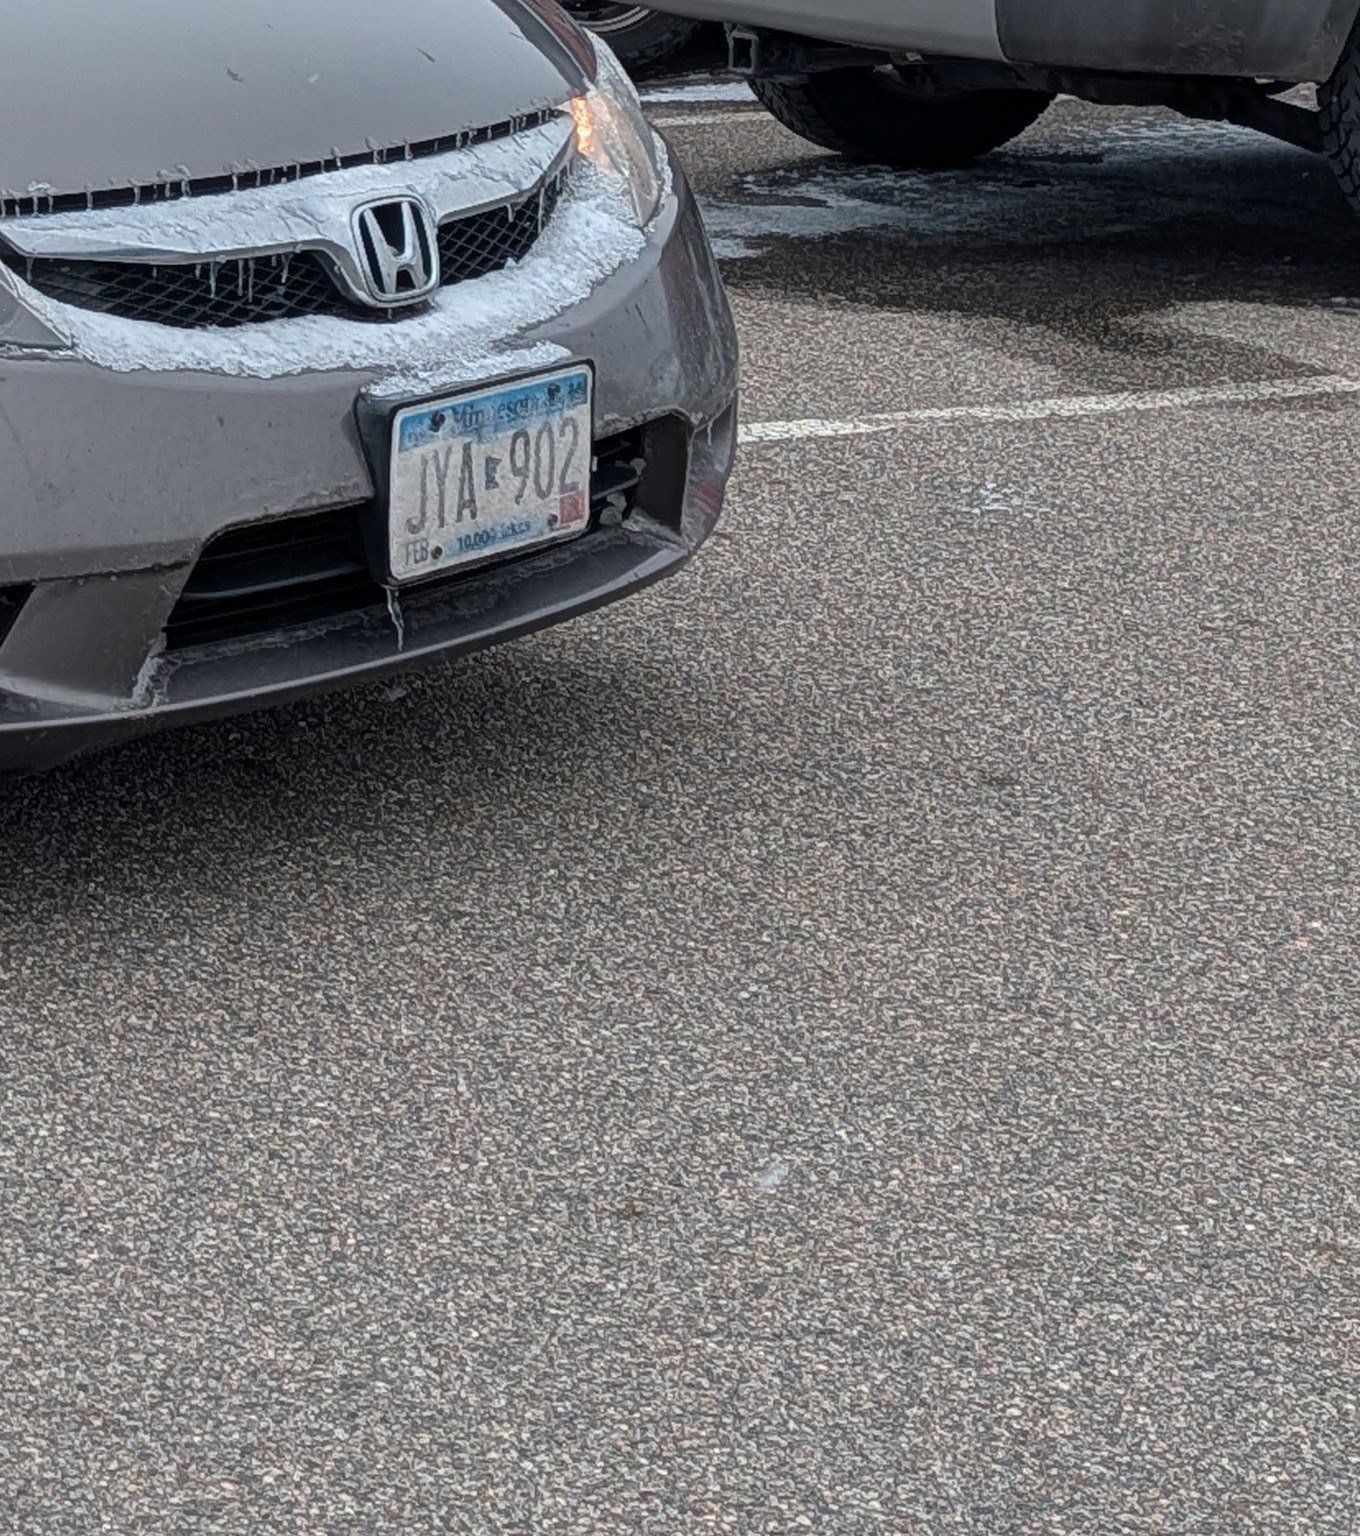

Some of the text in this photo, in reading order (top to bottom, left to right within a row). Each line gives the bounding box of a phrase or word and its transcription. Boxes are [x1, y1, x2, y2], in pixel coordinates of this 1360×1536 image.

[406, 417, 579, 534] JYA 902
[405, 537, 430, 565] FEB
